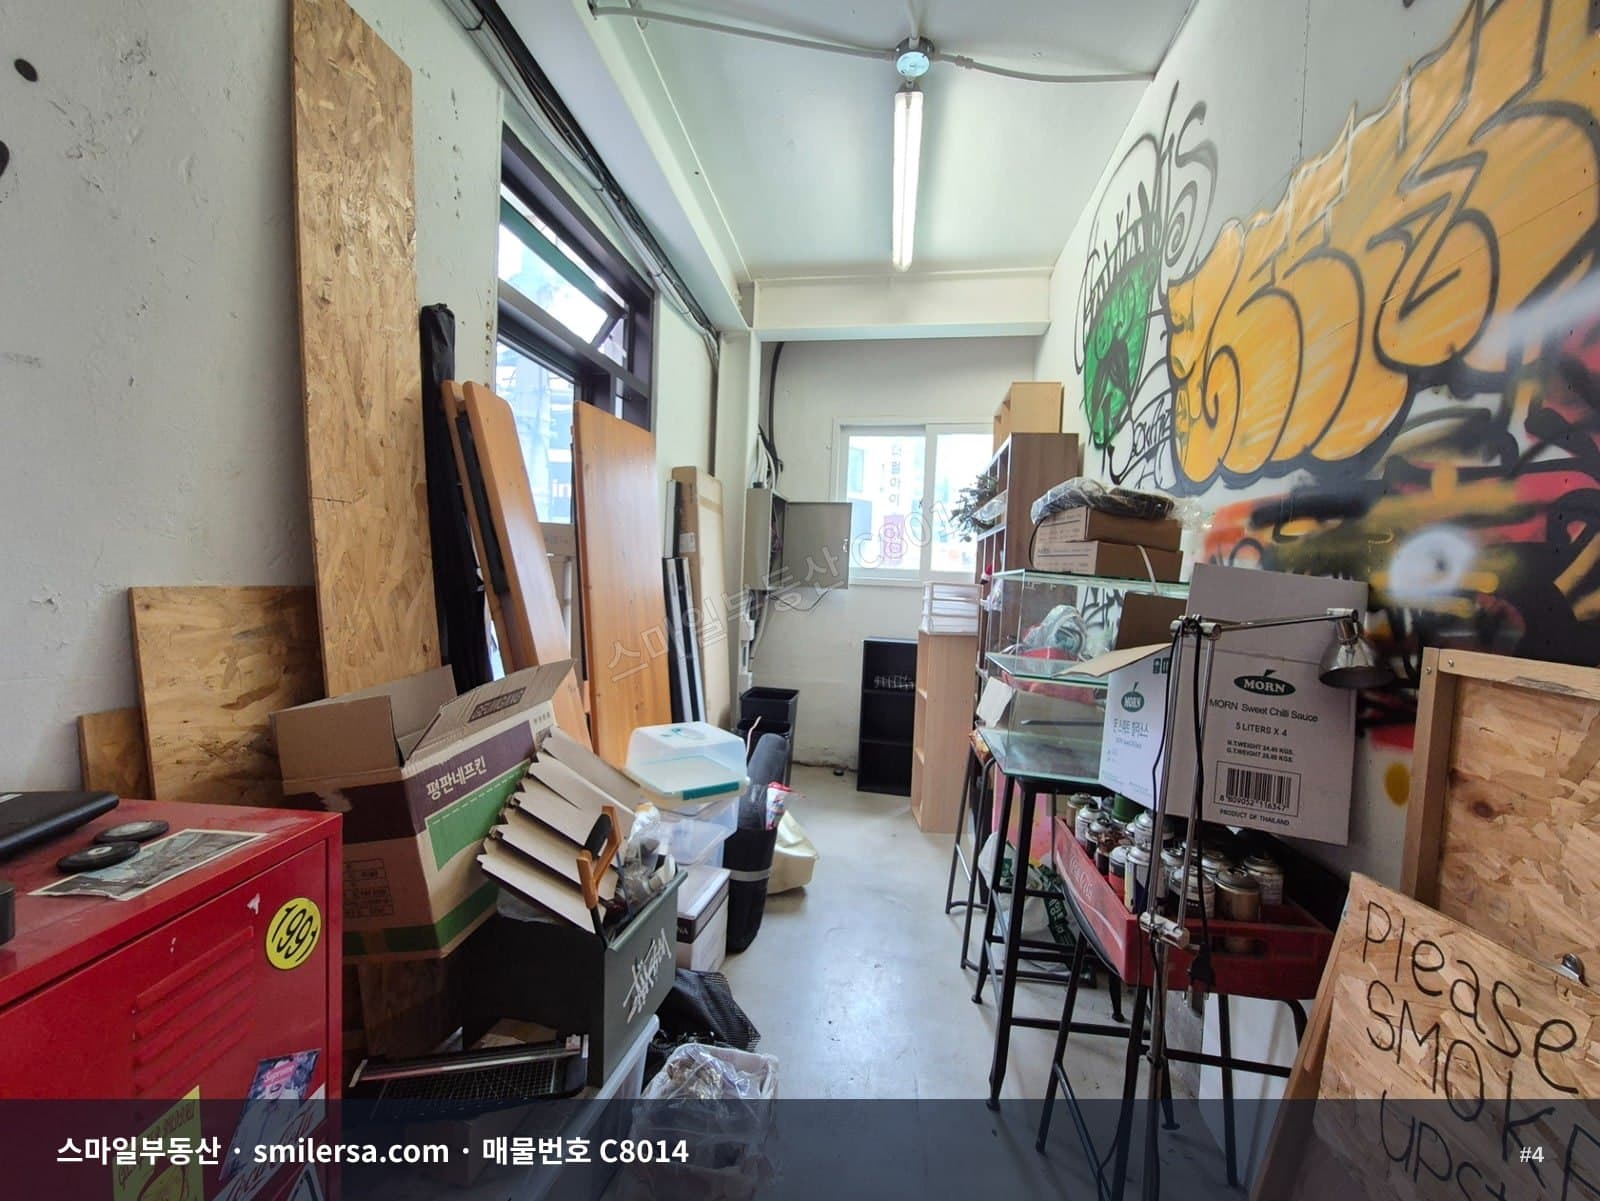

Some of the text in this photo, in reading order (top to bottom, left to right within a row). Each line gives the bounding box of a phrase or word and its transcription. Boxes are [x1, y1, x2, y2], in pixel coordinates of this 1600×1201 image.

[1243, 678, 1286, 694] MORN
[1209, 698, 1239, 710] MORN
[1241, 703, 1268, 715] Sweet
[1291, 710, 1319, 722] Sauce
[1235, 721, 1288, 737] 5 LITERS X 4
[426, 755, 488, 801] 평판네프킨
[1220, 809, 1290, 826] PRODUCT OF THAILAND
[271, 904, 319, 963] 1991
[1363, 900, 1579, 1095] Please
